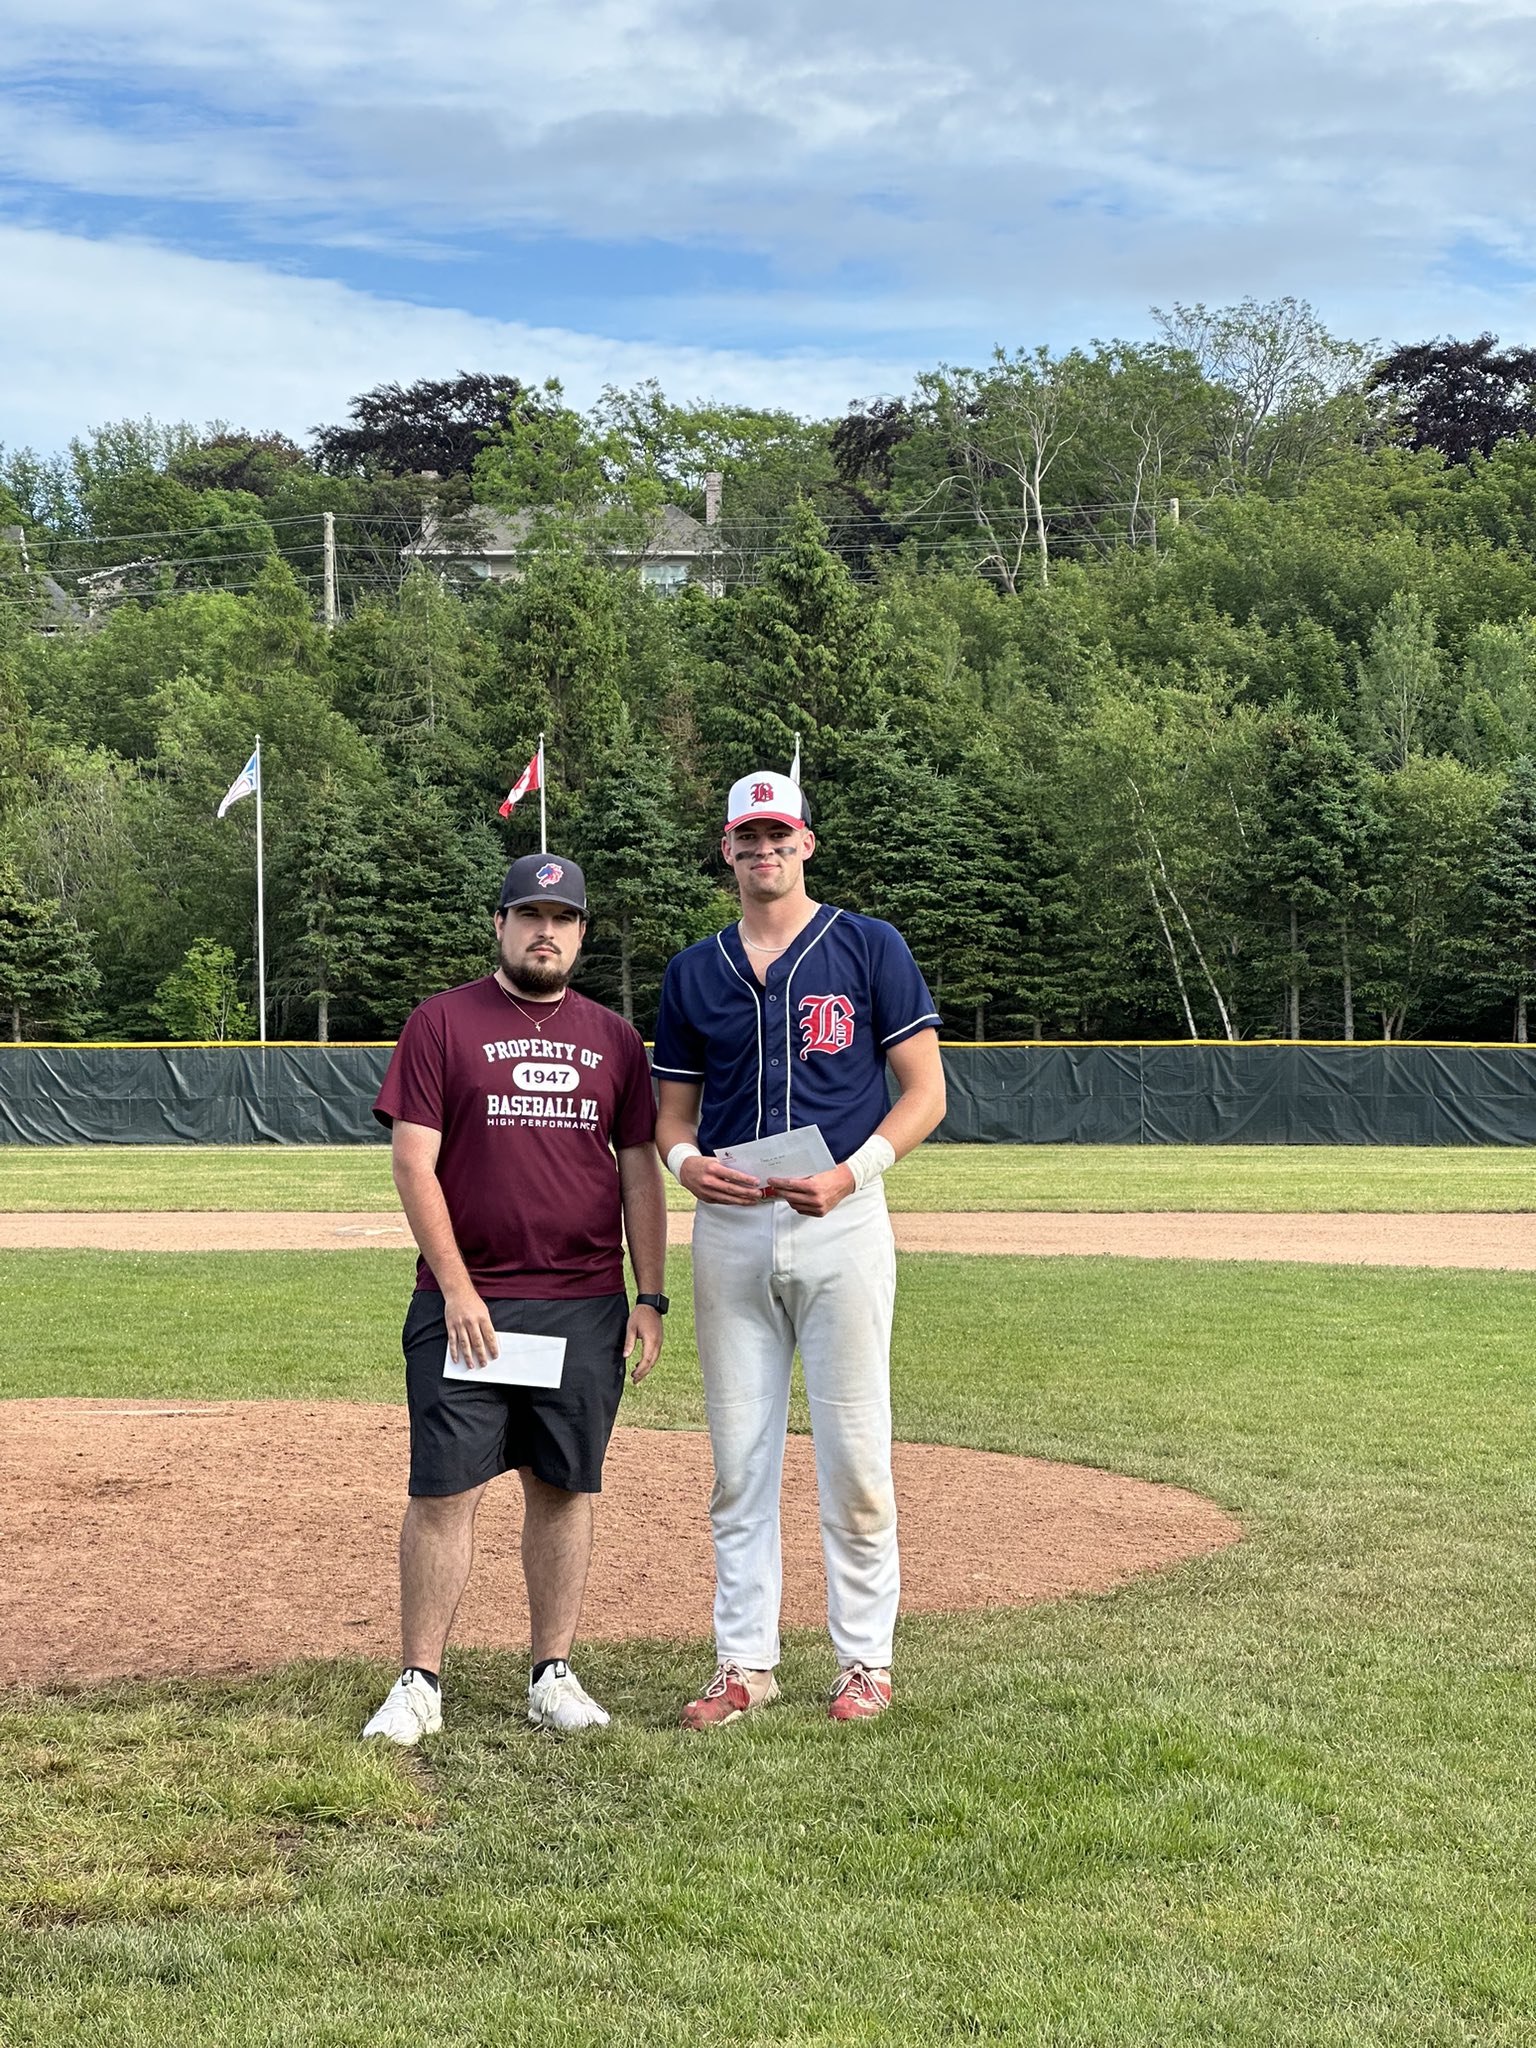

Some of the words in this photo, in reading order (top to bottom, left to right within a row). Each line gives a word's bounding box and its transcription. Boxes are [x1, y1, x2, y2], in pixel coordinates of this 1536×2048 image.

[750, 782, 774, 807] B
[798, 994, 855, 1061] B
[482, 1038, 576, 1063] PROPERTY
[580, 1048, 603, 1069] OF
[522, 1069, 570, 1084] 1947
[487, 1095, 577, 1118] BASEBALL
[580, 1098, 599, 1121] NL
[487, 1118, 515, 1126] HIGH
[520, 1119, 597, 1131] PERFORMANCE
